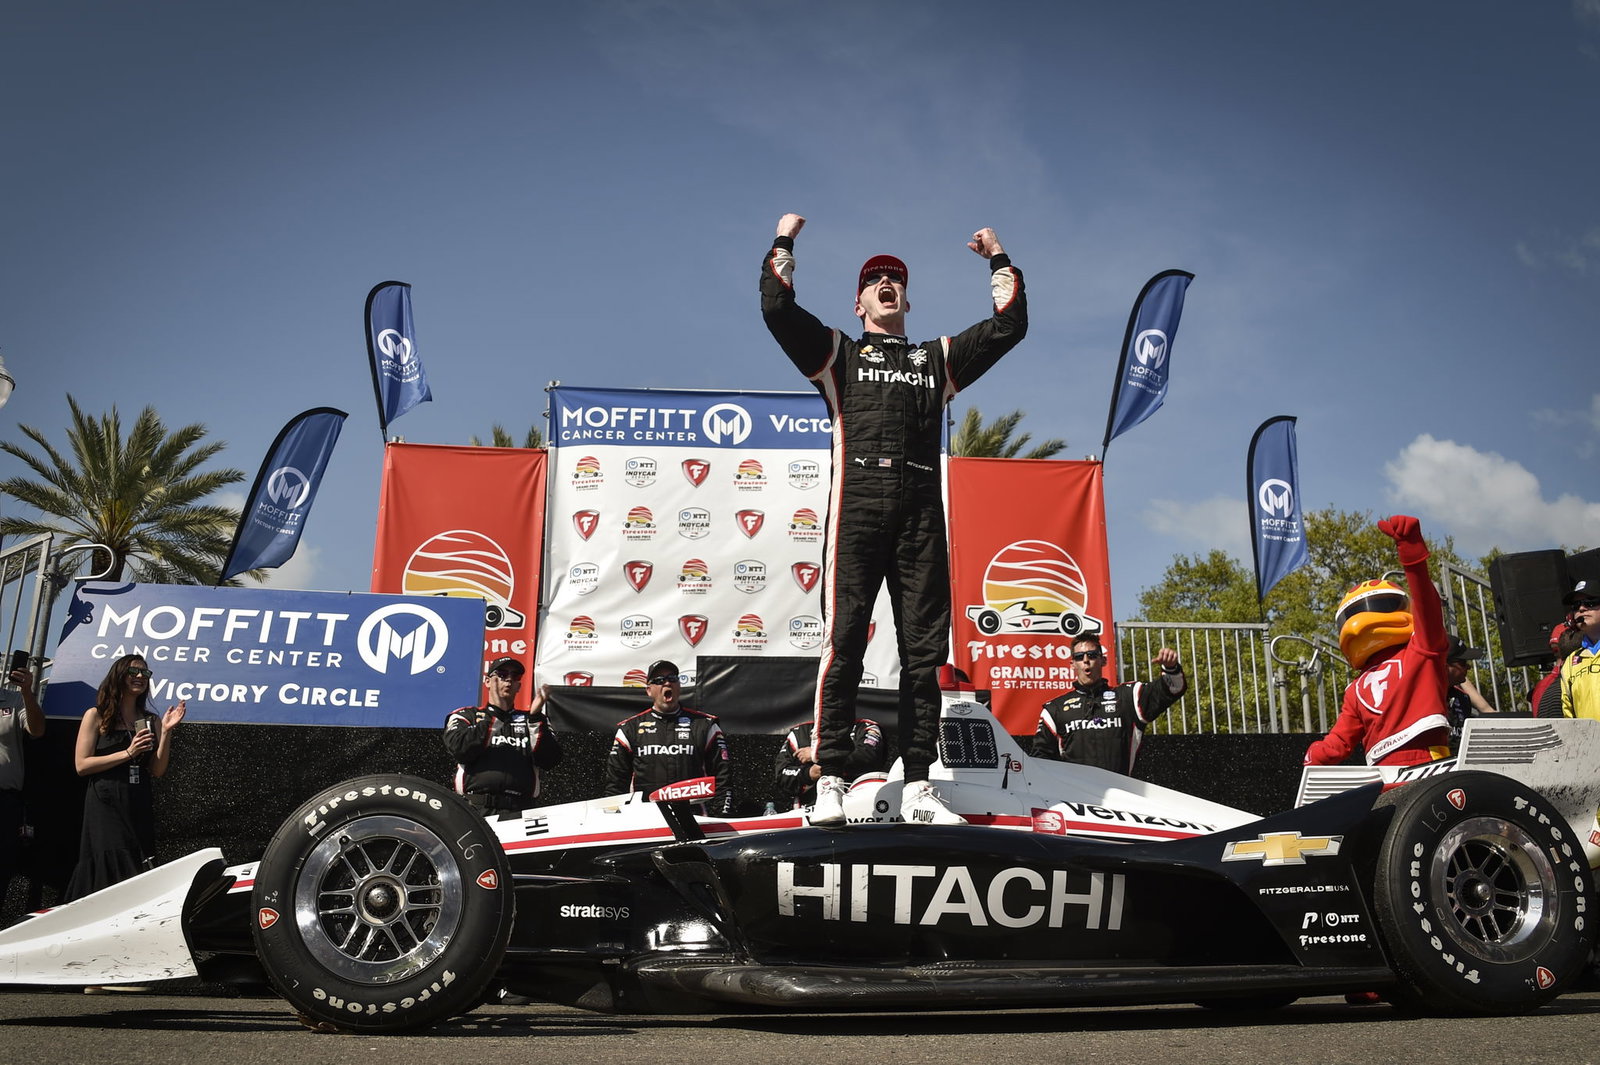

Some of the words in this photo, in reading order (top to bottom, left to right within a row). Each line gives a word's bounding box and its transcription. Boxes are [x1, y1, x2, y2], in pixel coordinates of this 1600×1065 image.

[382, 360, 416, 372] MOFFITT
[1130, 364, 1162, 382] MOFFITT
[858, 368, 935, 388] HITACHI
[562, 406, 696, 430] MOFFITT
[769, 414, 833, 433] VICTO
[562, 430, 625, 440] CANCER
[634, 431, 696, 442] CENTER
[259, 502, 301, 521] MOFFITT
[1262, 518, 1298, 529] MOFFITT
[97, 604, 350, 646] MOFFITT
[90, 643, 212, 664] CANCER
[226, 648, 343, 668] CENTER
[967, 640, 1107, 663] Firesto
[990, 666, 1048, 679] GRAND
[1049, 667, 1078, 680] PRI
[148, 678, 270, 702] VICTORY
[278, 682, 380, 708] CIRCLE
[1065, 718, 1122, 734] HITACHI
[637, 744, 694, 757] HITACHI
[658, 782, 714, 800] Mazak
[305, 784, 442, 826] Firestone
[1060, 800, 1216, 832] verizon
[1514, 796, 1586, 932] Firestone
[777, 862, 1126, 930] HITACHI
[1259, 885, 1324, 895] FITZGERALD
[560, 904, 630, 920] stratasys
[1340, 914, 1360, 924] NTT
[1410, 842, 1480, 984] Firestone
[1299, 934, 1366, 946] Firestone
[312, 970, 456, 1016] Firestone
